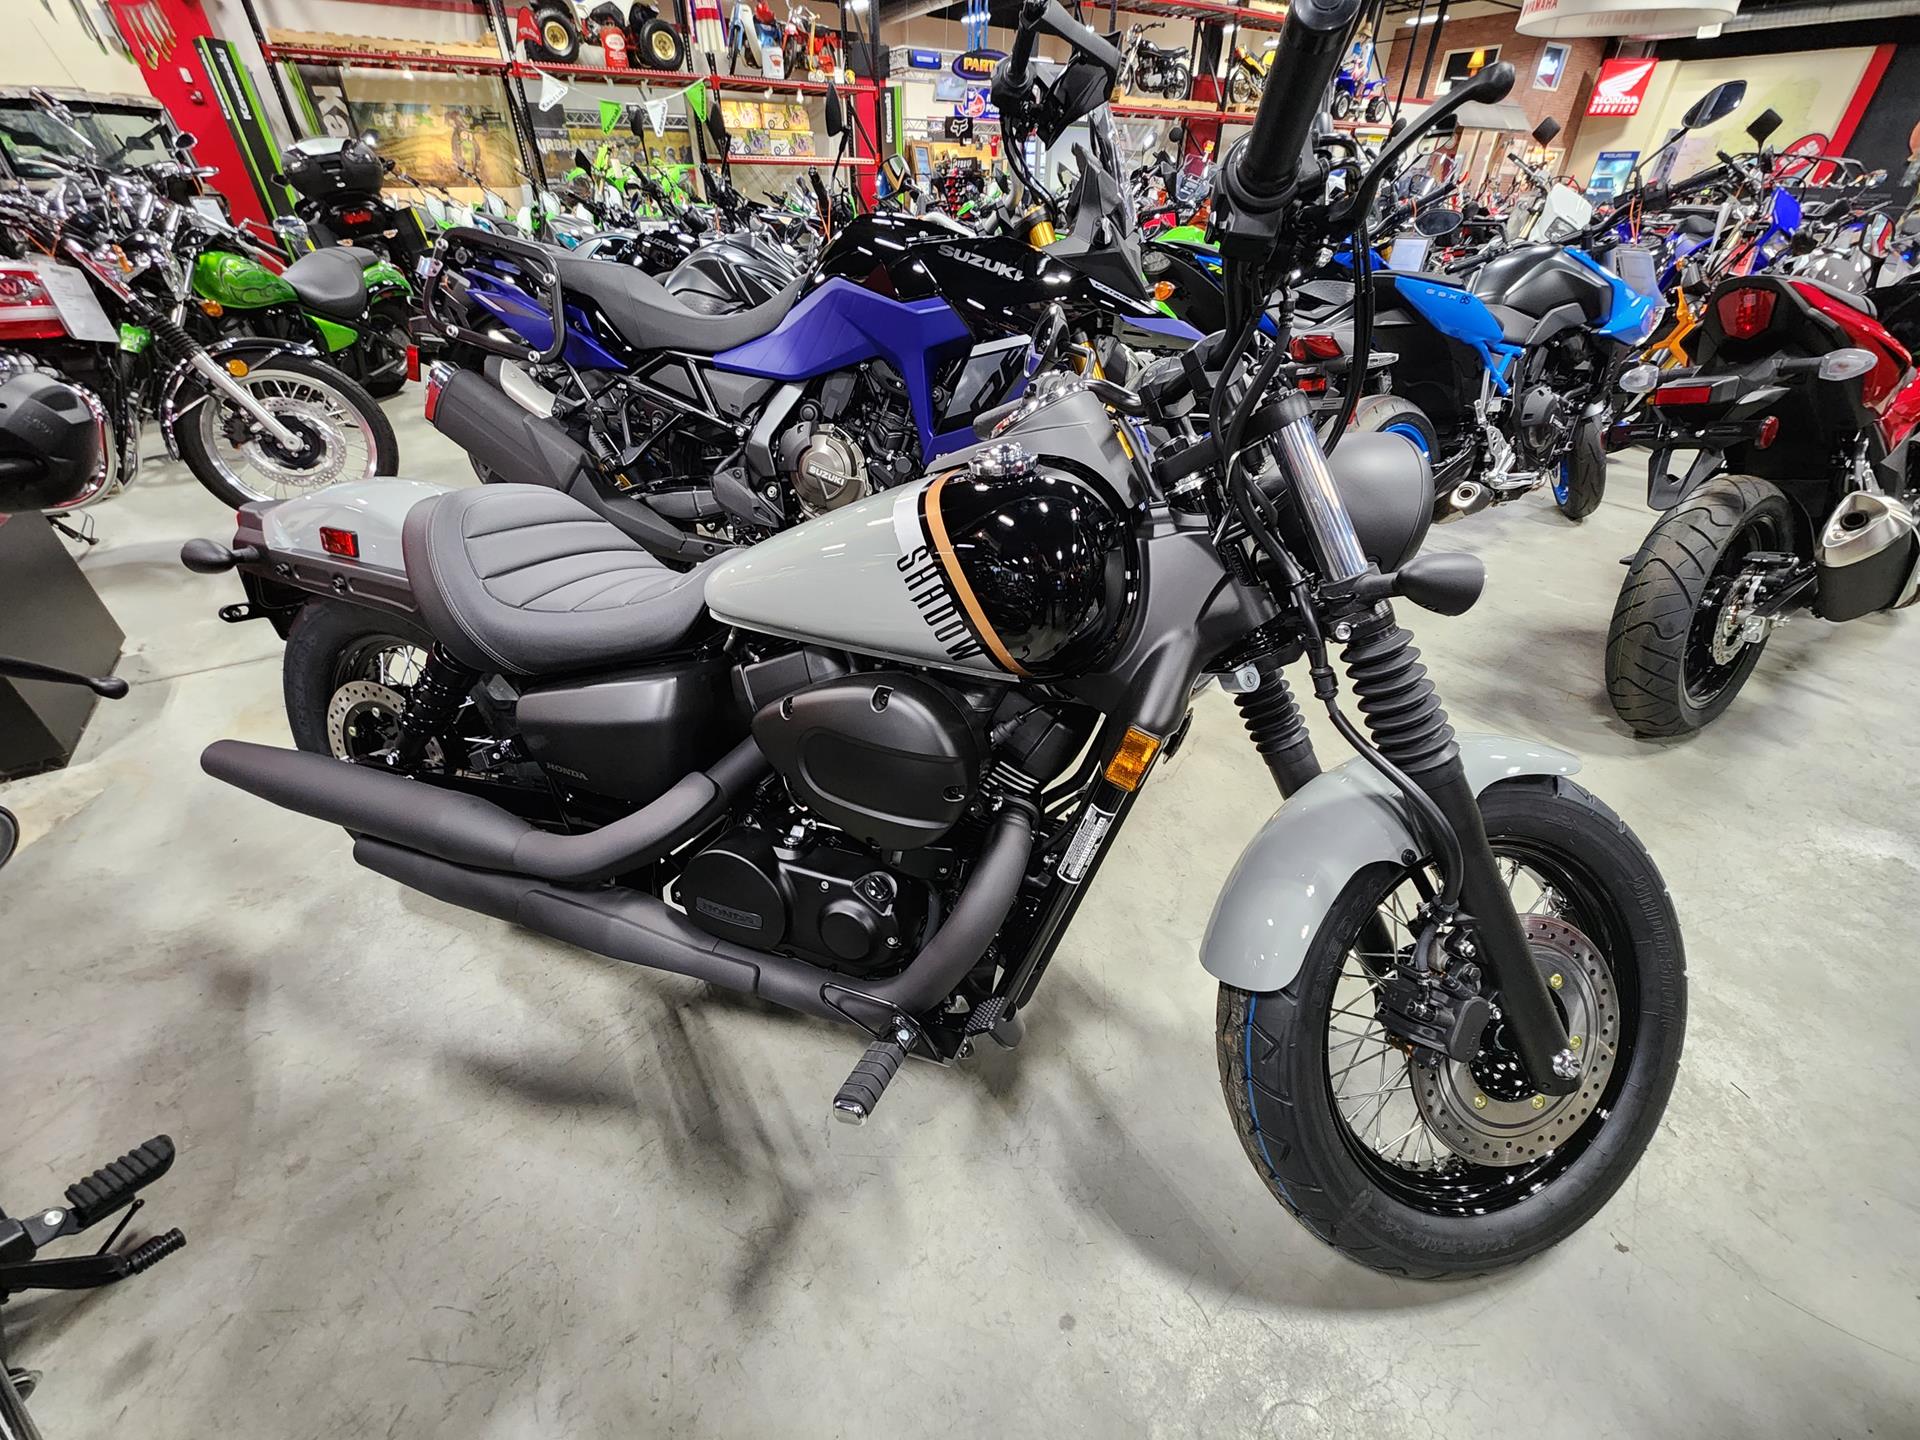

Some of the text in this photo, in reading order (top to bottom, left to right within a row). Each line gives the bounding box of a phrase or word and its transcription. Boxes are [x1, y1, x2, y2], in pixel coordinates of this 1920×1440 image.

[963, 57, 1000, 72] PART
[1589, 104, 1638, 114] SERVICE
[1593, 95, 1639, 104] HONDA
[884, 92, 893, 143] Kawasaki
[938, 243, 1025, 282] SUZUKI
[809, 464, 845, 486] SUZUKI
[896, 545, 985, 661] SHADOW
[546, 762, 589, 781] HONDA
